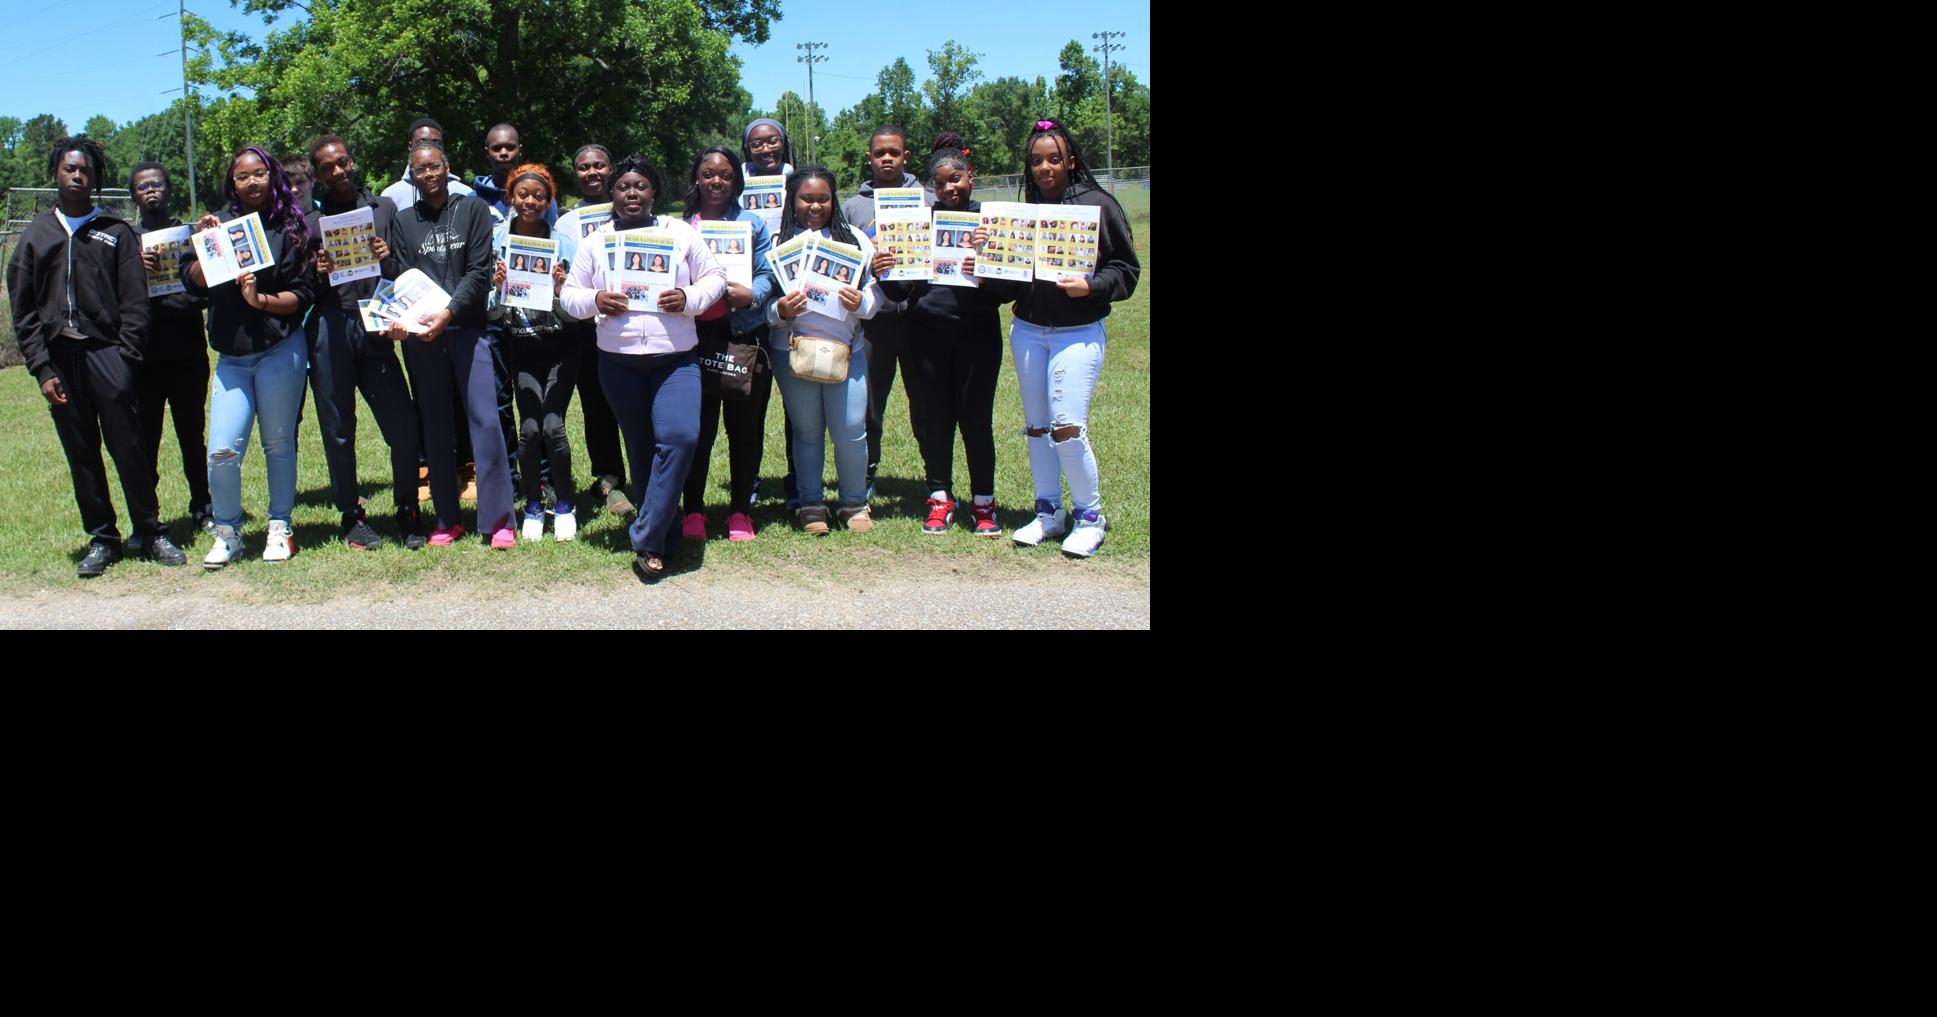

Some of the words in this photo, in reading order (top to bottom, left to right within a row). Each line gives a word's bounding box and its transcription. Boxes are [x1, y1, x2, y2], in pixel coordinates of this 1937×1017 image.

[418, 241, 465, 255] Sportsear
[715, 352, 735, 363] THE
[699, 357, 725, 369] TOTE
[726, 363, 748, 374] BAG
